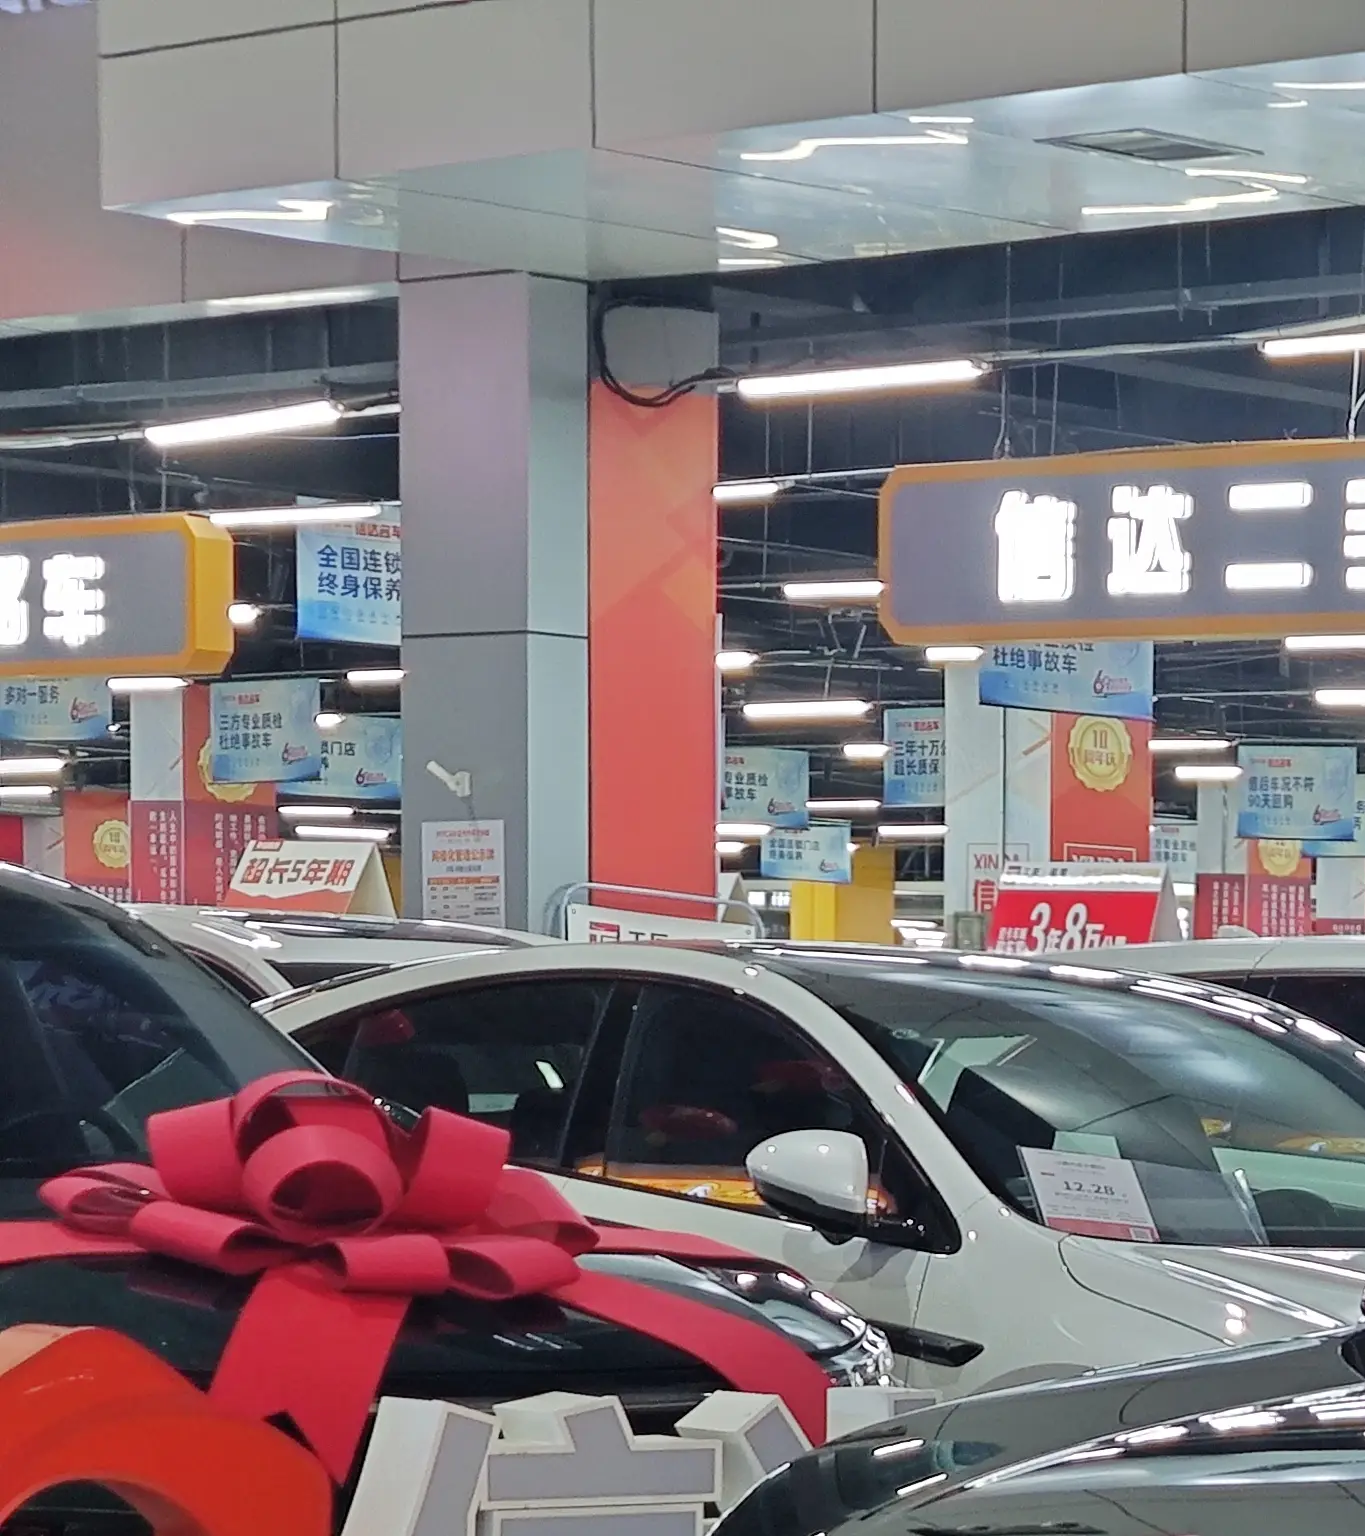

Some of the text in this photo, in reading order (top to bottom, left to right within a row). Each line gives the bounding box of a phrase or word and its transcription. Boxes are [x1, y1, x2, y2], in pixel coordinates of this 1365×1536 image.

[992, 647, 1078, 674] 杜绝事故车
[219, 712, 283, 730] 三方专业质检
[218, 733, 273, 751] 杜绝事故车
